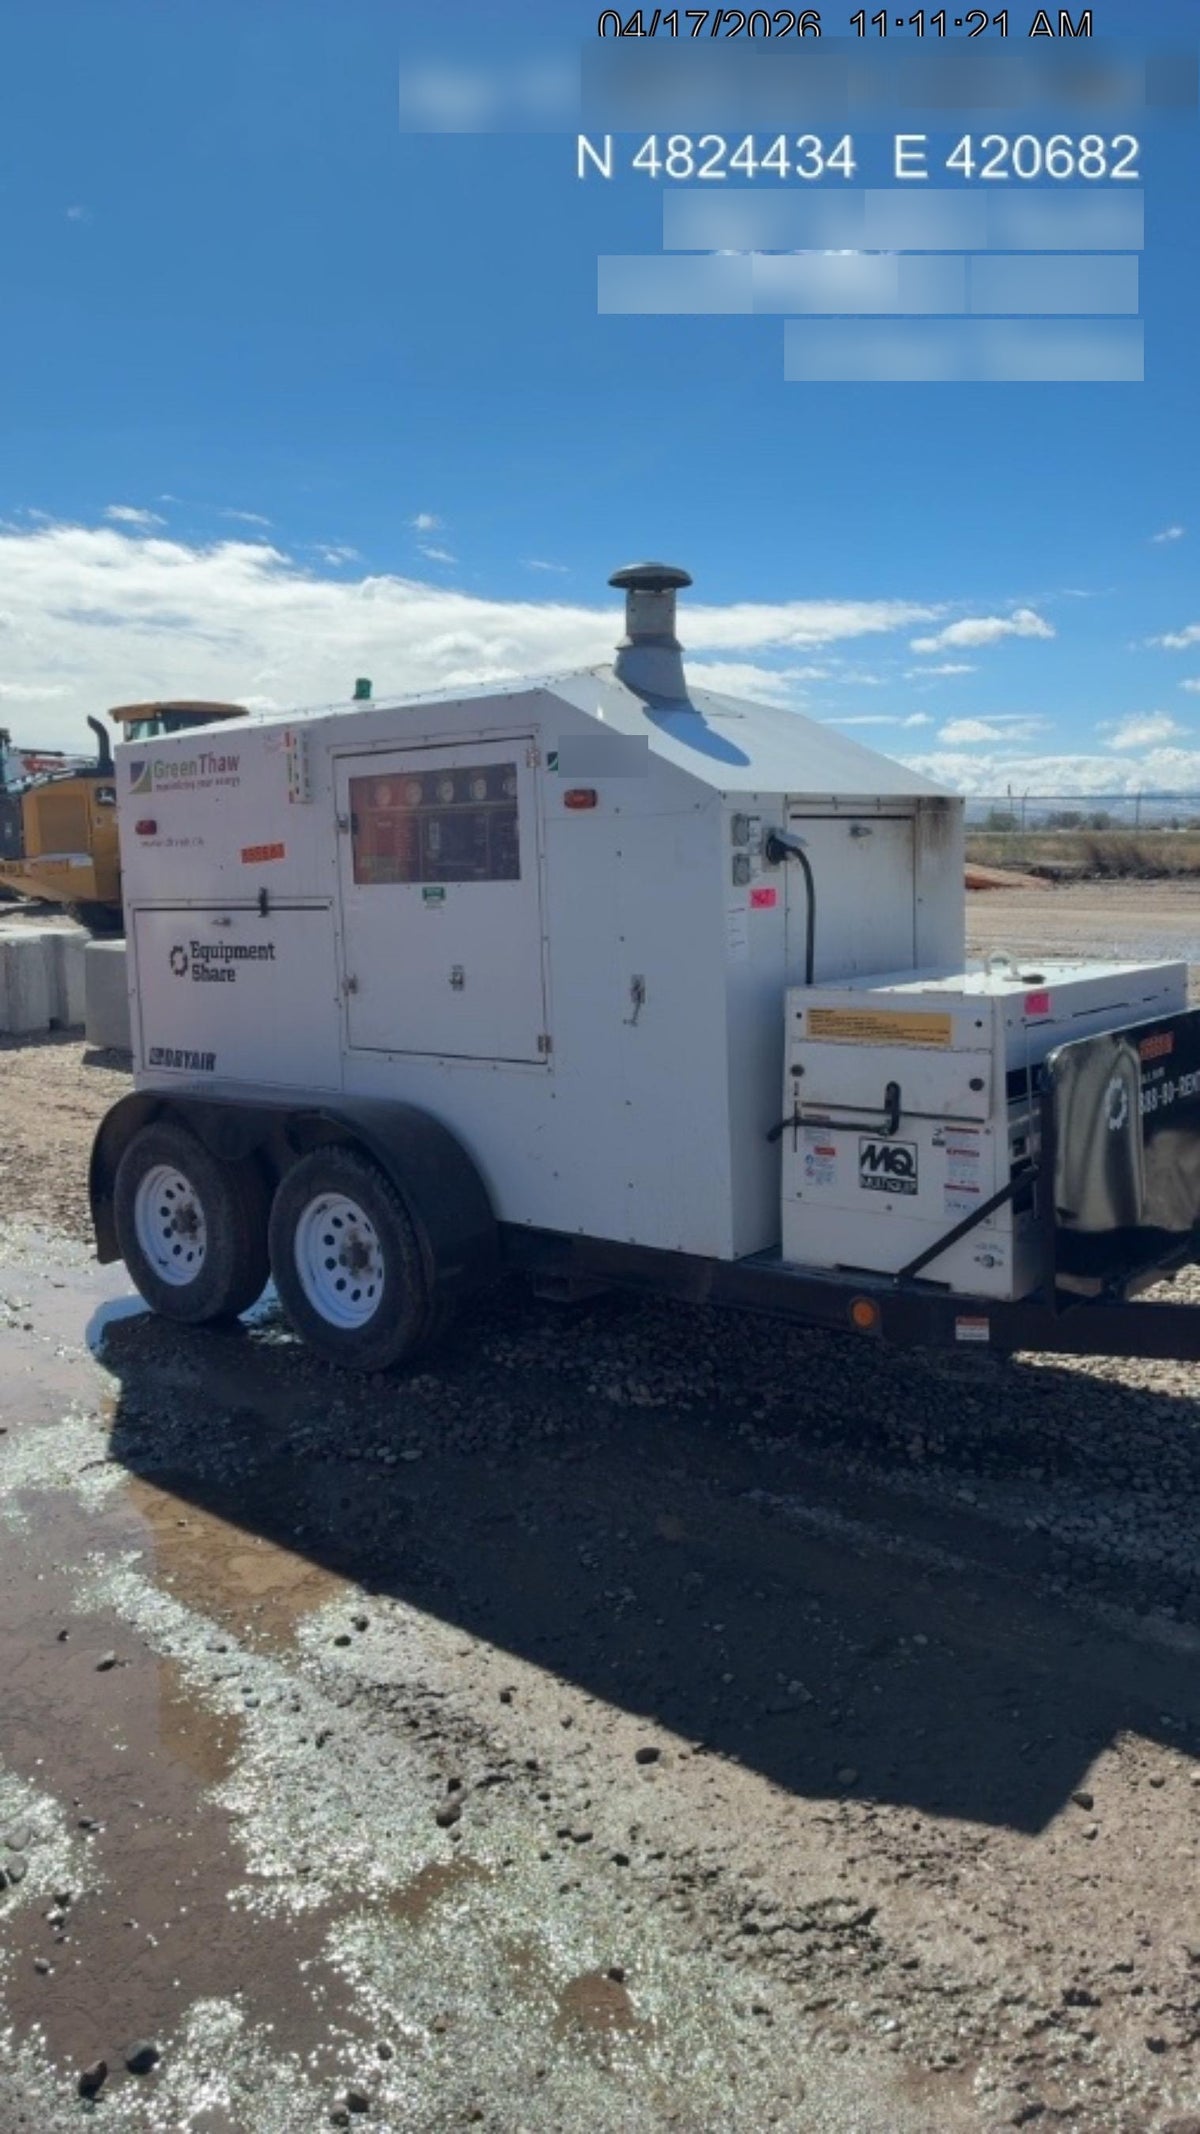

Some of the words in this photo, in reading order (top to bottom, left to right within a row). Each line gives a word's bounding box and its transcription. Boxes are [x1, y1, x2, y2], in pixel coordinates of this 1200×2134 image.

[153, 751, 240, 779] GreenThaw
[190, 941, 276, 963] Equipment
[192, 964, 236, 982] Share
[860, 1145, 916, 1178] MQ
